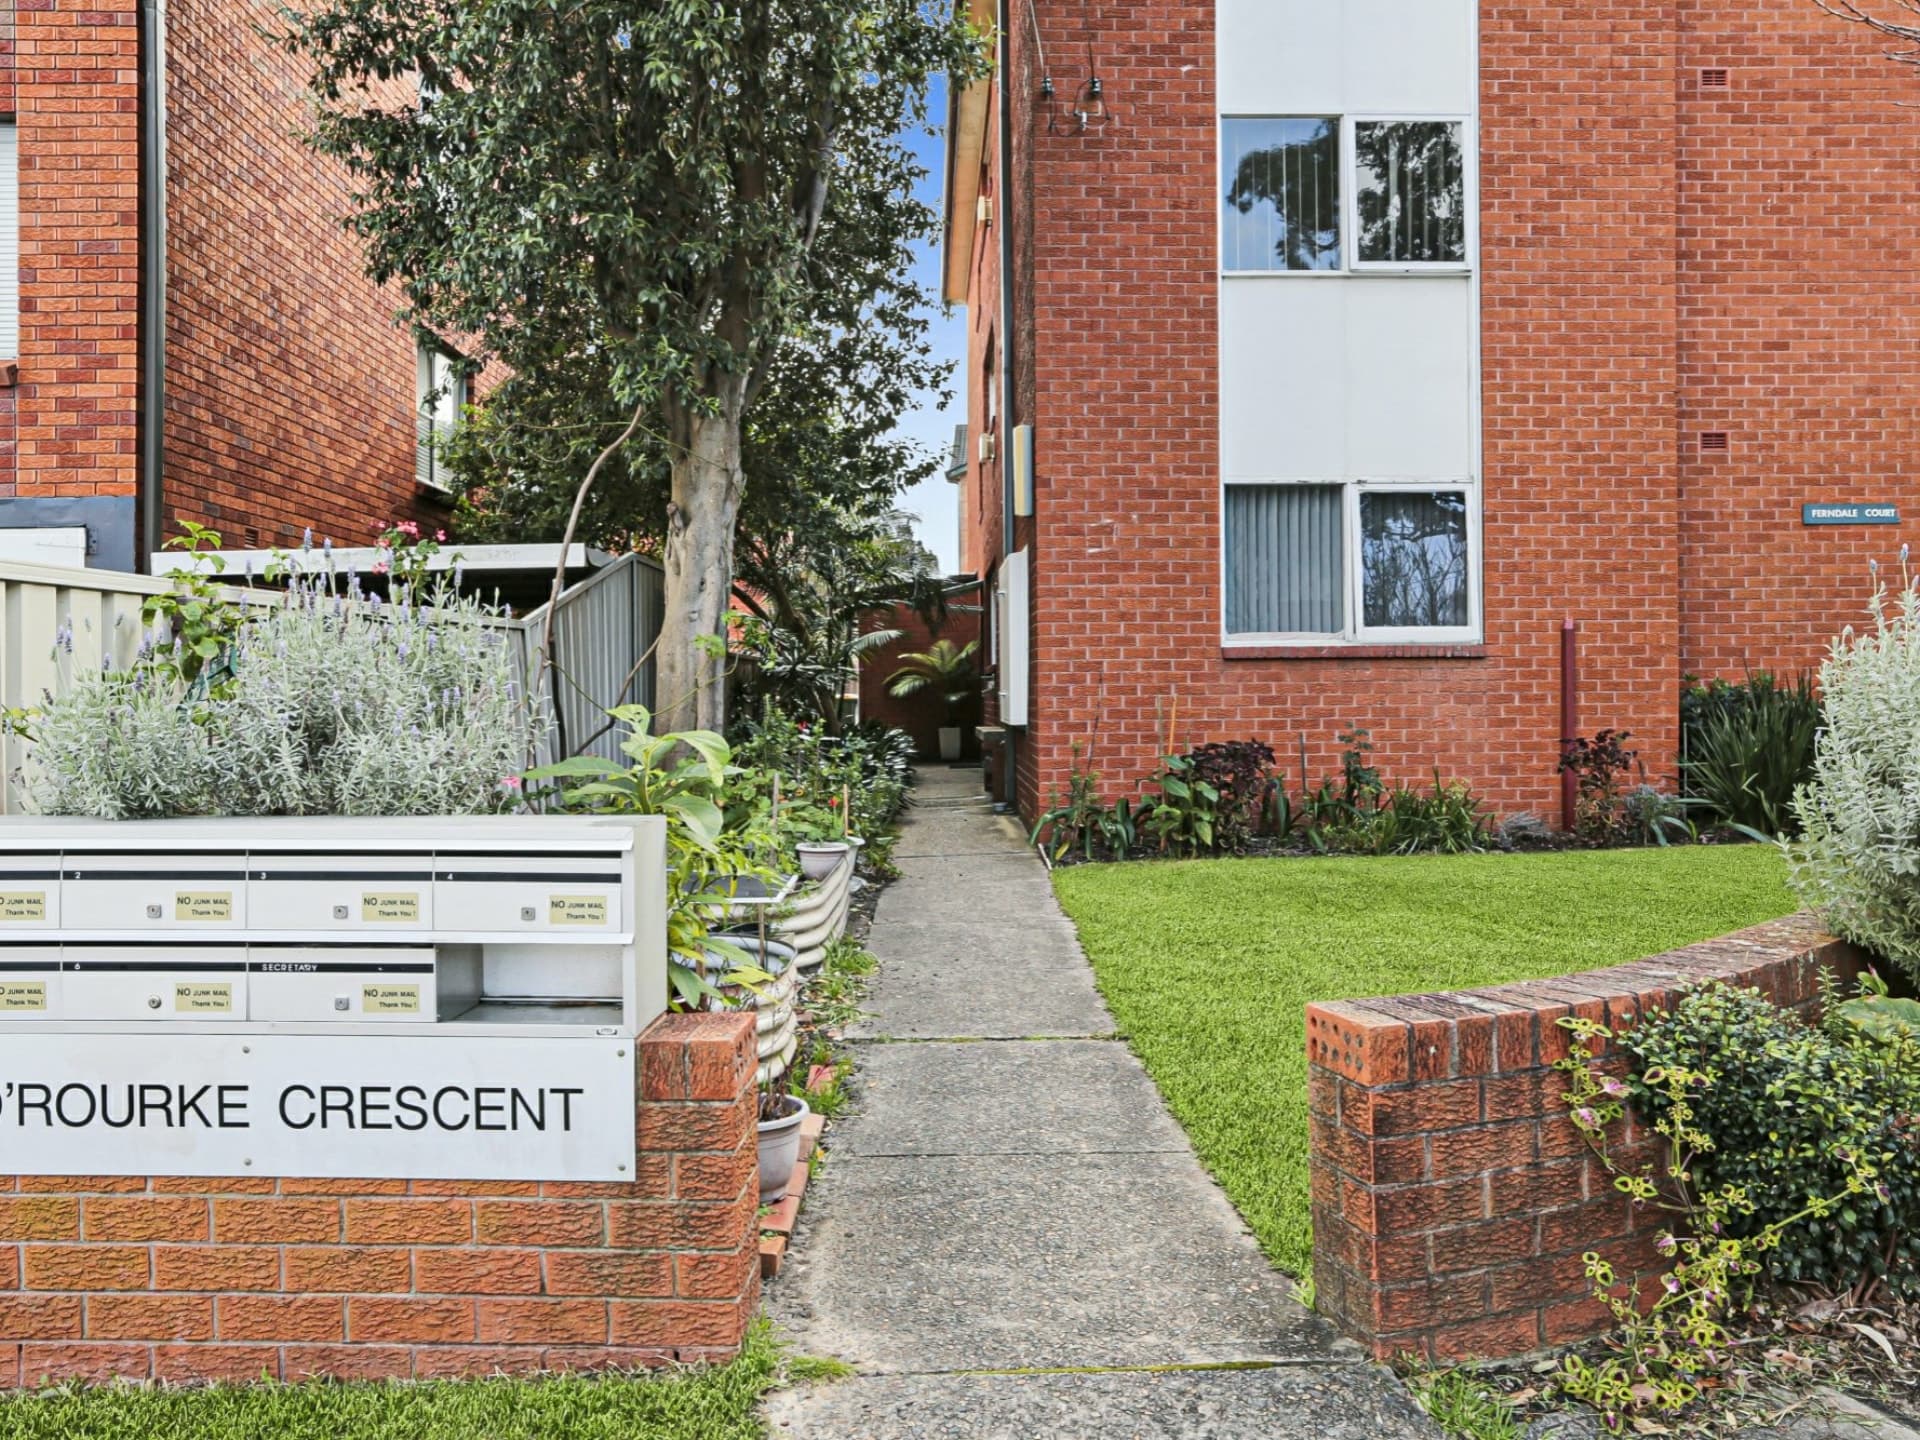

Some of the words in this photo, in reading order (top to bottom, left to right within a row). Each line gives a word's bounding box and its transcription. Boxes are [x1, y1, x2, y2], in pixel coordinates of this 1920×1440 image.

[1811, 508, 1859, 518] FERNDALE
[1864, 508, 1896, 518] COURT
[74, 871, 81, 879] 2
[260, 872, 267, 880] 3
[447, 873, 454, 881] 4
[177, 896, 191, 905] NO
[364, 897, 378, 906] NO
[551, 900, 565, 909] NO
[74, 962, 81, 970] 6
[262, 963, 318, 972] SECRETARY
[177, 988, 191, 997] NO
[364, 989, 378, 998] NO
[0, 1082, 250, 1128] 'ROURKE
[279, 1084, 584, 1131] CRESCENT
